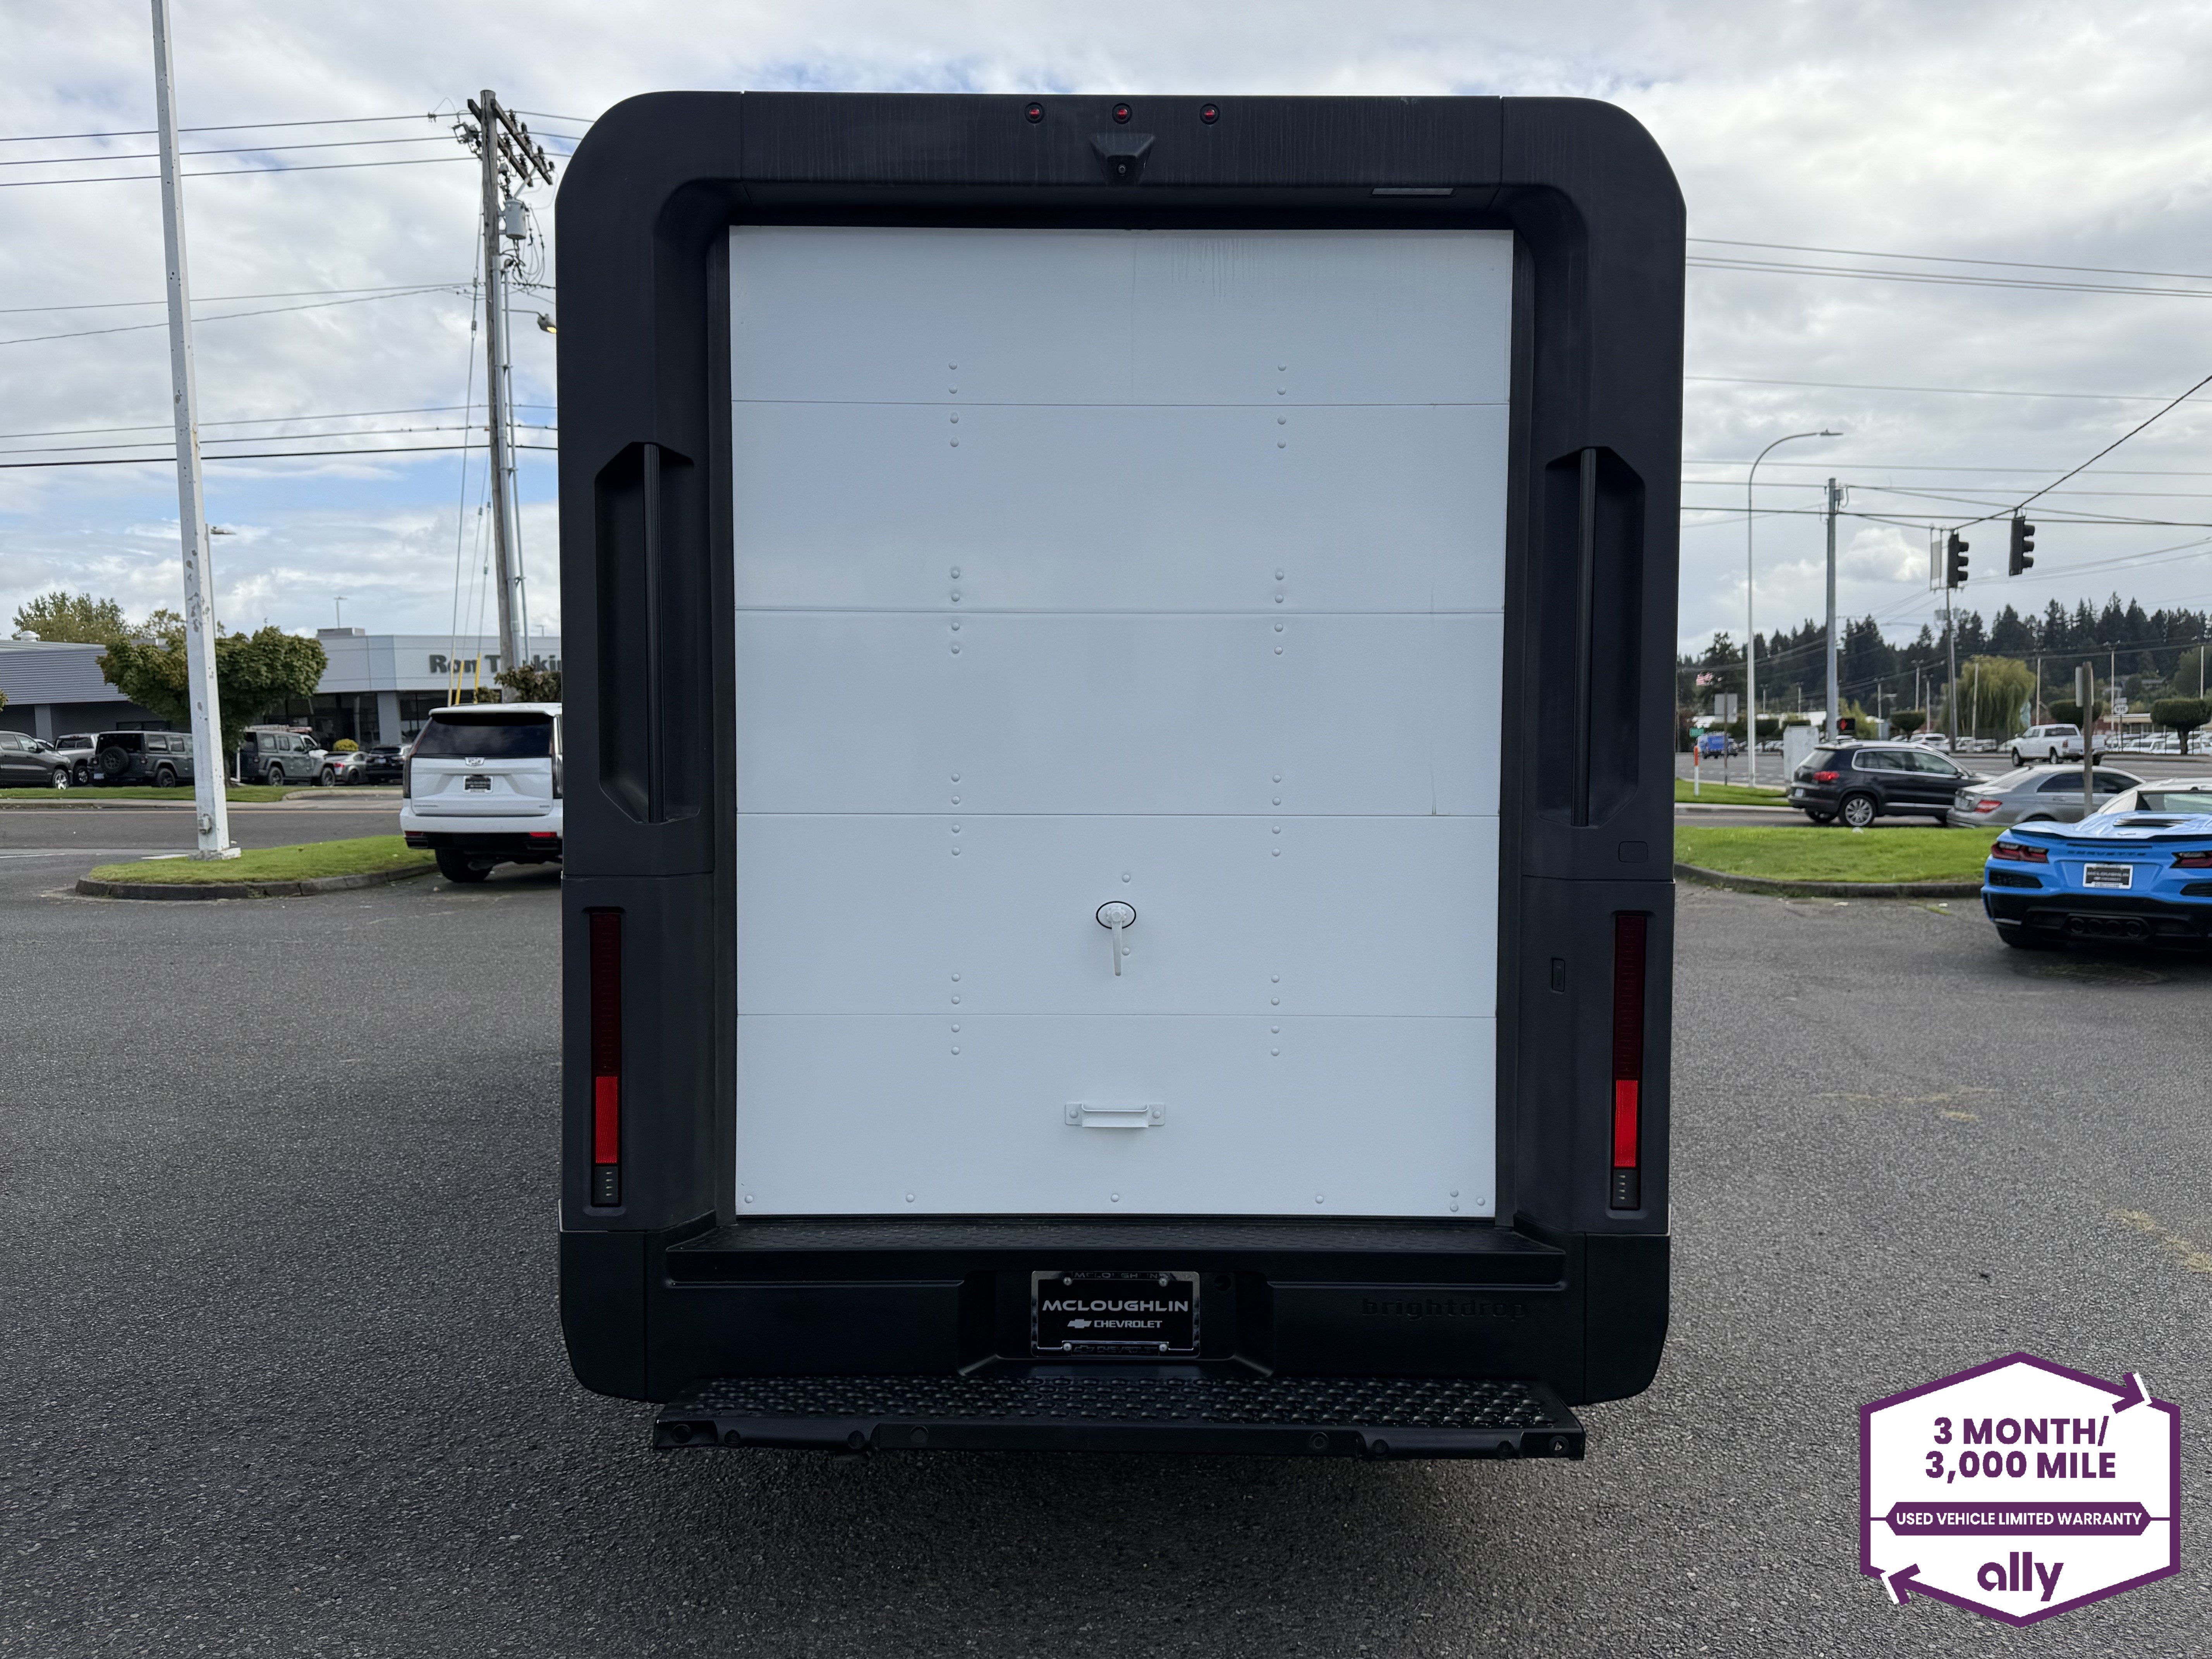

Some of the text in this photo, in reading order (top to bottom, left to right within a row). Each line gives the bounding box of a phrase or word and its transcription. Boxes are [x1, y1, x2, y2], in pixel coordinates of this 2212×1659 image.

[429, 654, 478, 673] Ron
[1042, 1300, 1188, 1312] MCLOUGHLIN
[1362, 1298, 1525, 1321] brightdrop
[1094, 1320, 1163, 1328] CHEVROLET
